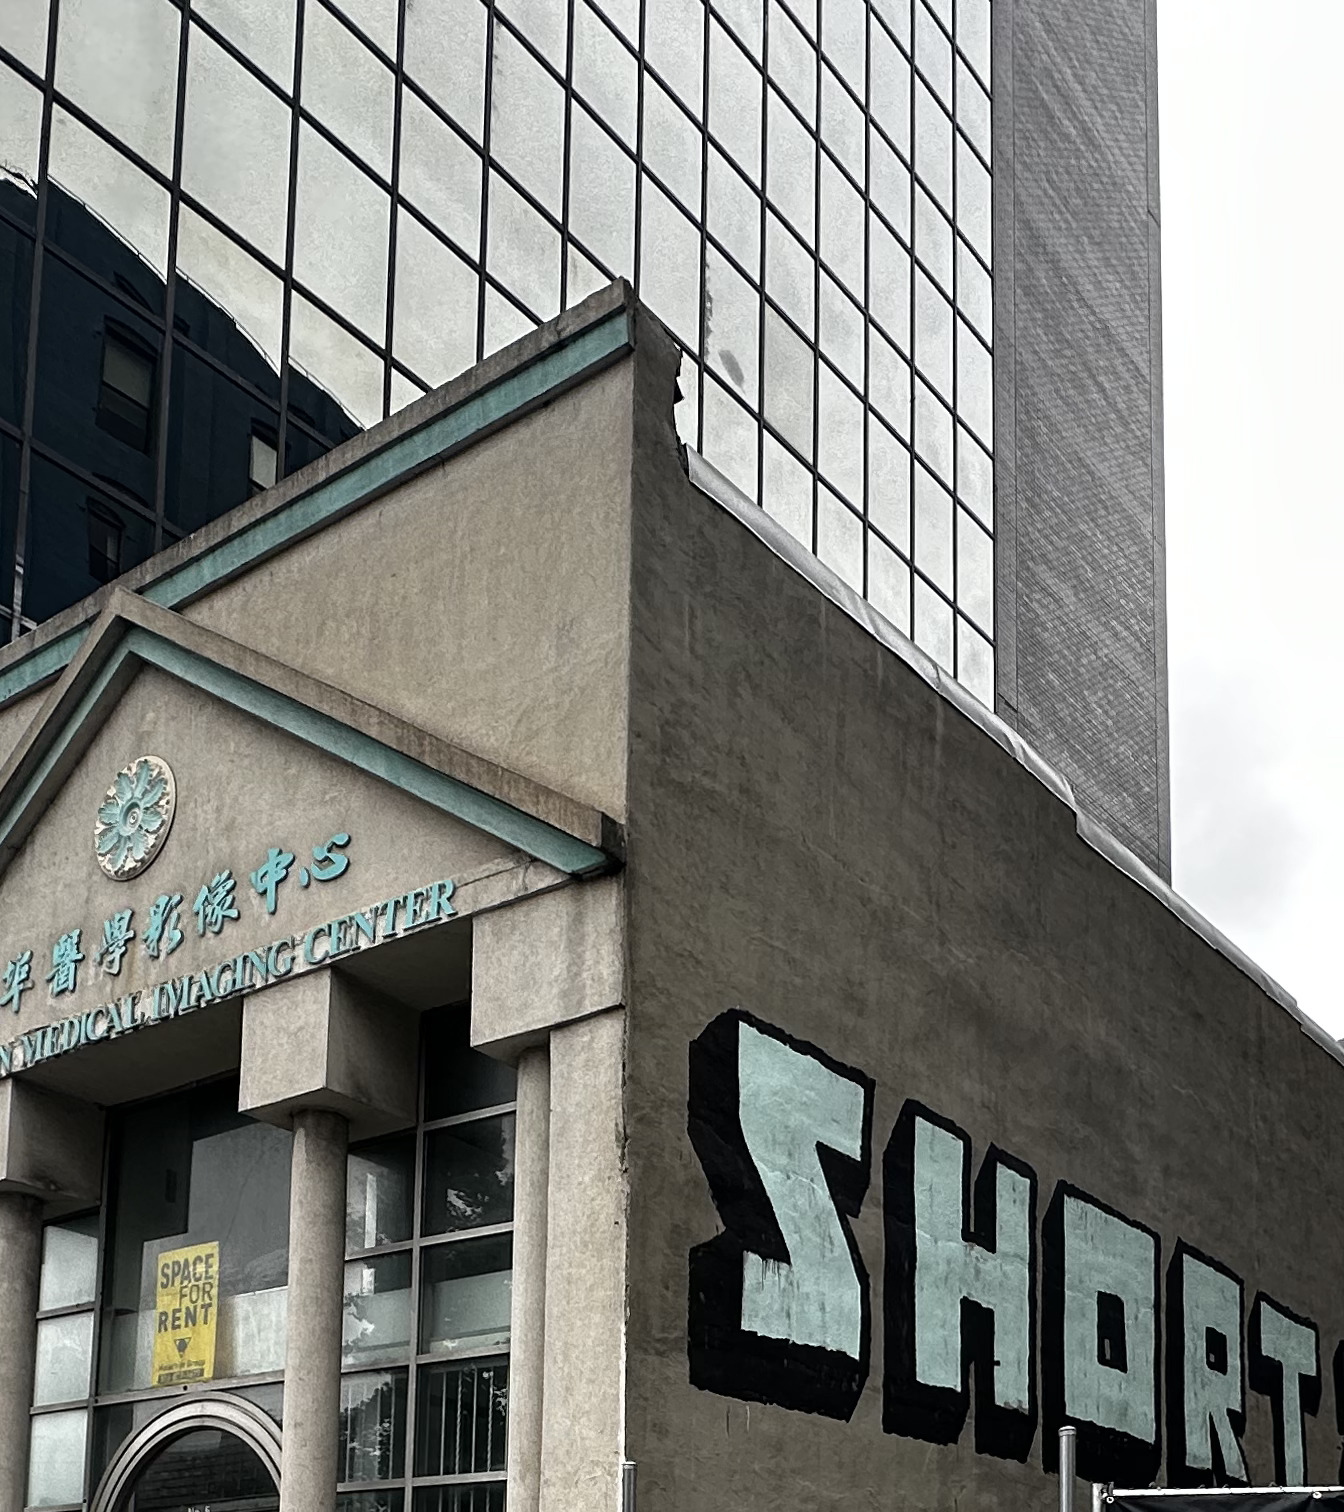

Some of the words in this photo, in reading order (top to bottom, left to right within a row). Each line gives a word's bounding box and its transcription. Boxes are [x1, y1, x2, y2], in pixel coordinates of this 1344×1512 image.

[20, 991, 142, 1067] MEDICAL
[151, 941, 295, 1021] IMAGING
[304, 879, 456, 965] CENTER
[160, 1253, 214, 1289] SPACE
[179, 1281, 213, 1308] FOR
[158, 1303, 212, 1333] RENT
